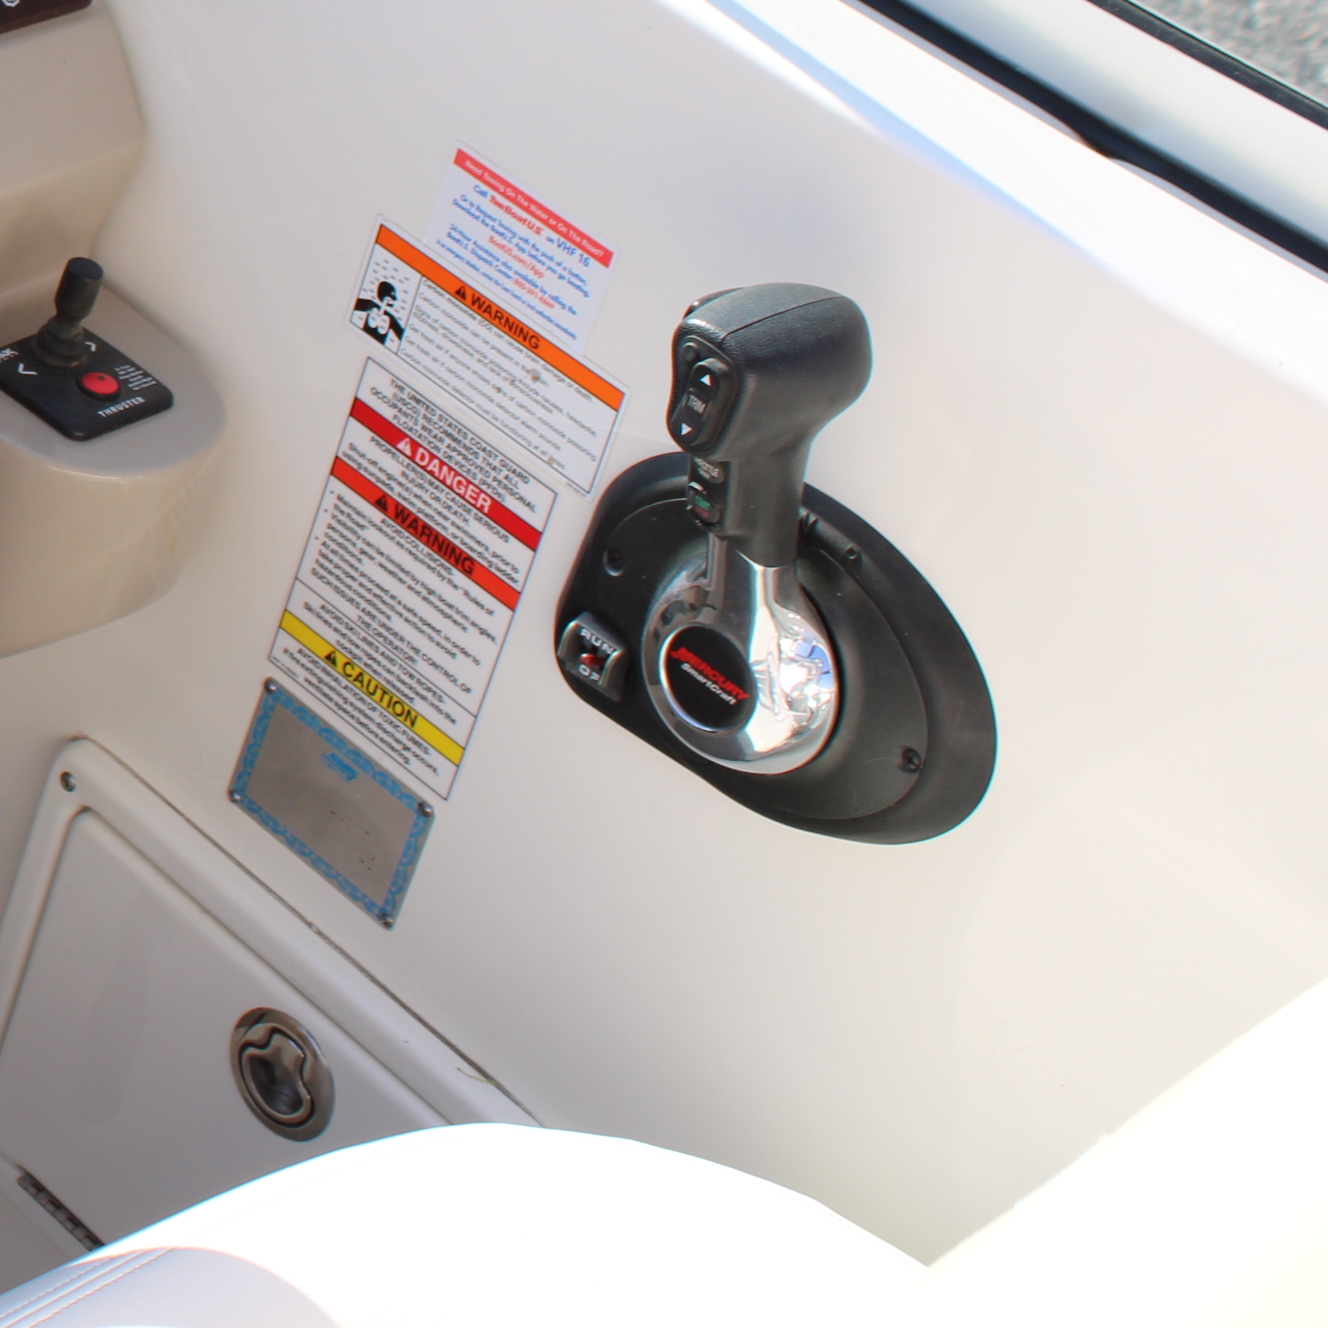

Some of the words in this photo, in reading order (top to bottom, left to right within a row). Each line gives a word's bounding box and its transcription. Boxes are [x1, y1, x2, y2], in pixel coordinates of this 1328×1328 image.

[465, 160, 482, 176] Need
[483, 172, 504, 192] Towing
[506, 187, 515, 198] On
[517, 195, 527, 206] The
[529, 203, 547, 220] Water
[557, 222, 567, 233] On
[569, 230, 579, 241] The
[582, 239, 603, 258] Road?
[474, 184, 487, 199] Call
[556, 238, 575, 258] VHF
[578, 252, 589, 267] 16
[469, 293, 540, 350] WARNING
[97, 396, 146, 417] THRUSTER
[389, 379, 405, 395] THE
[407, 391, 436, 417] UNITED
[437, 413, 467, 440] STATES
[469, 436, 497, 462] COAST
[499, 458, 529, 485] GUARD
[392, 392, 421, 418] (USCG)
[421, 413, 479, 460] RECOMMENDS
[481, 456, 501, 476] THAT
[503, 472, 519, 489] ALL
[370, 386, 418, 426] OCCUPANTS
[421, 424, 444, 445] WEAR
[445, 441, 490, 479] APPROVED
[491, 475, 537, 512] PERSONAL
[392, 413, 441, 454] FLOATATION
[442, 450, 477, 481] DEVICES
[414, 446, 492, 514] DANGER
[391, 503, 475, 576] WARNING
[580, 628, 614, 654] RUN
[670, 645, 750, 701] MERCURY
[341, 659, 418, 729] CAUTION
[680, 662, 738, 706] SmartCraft
